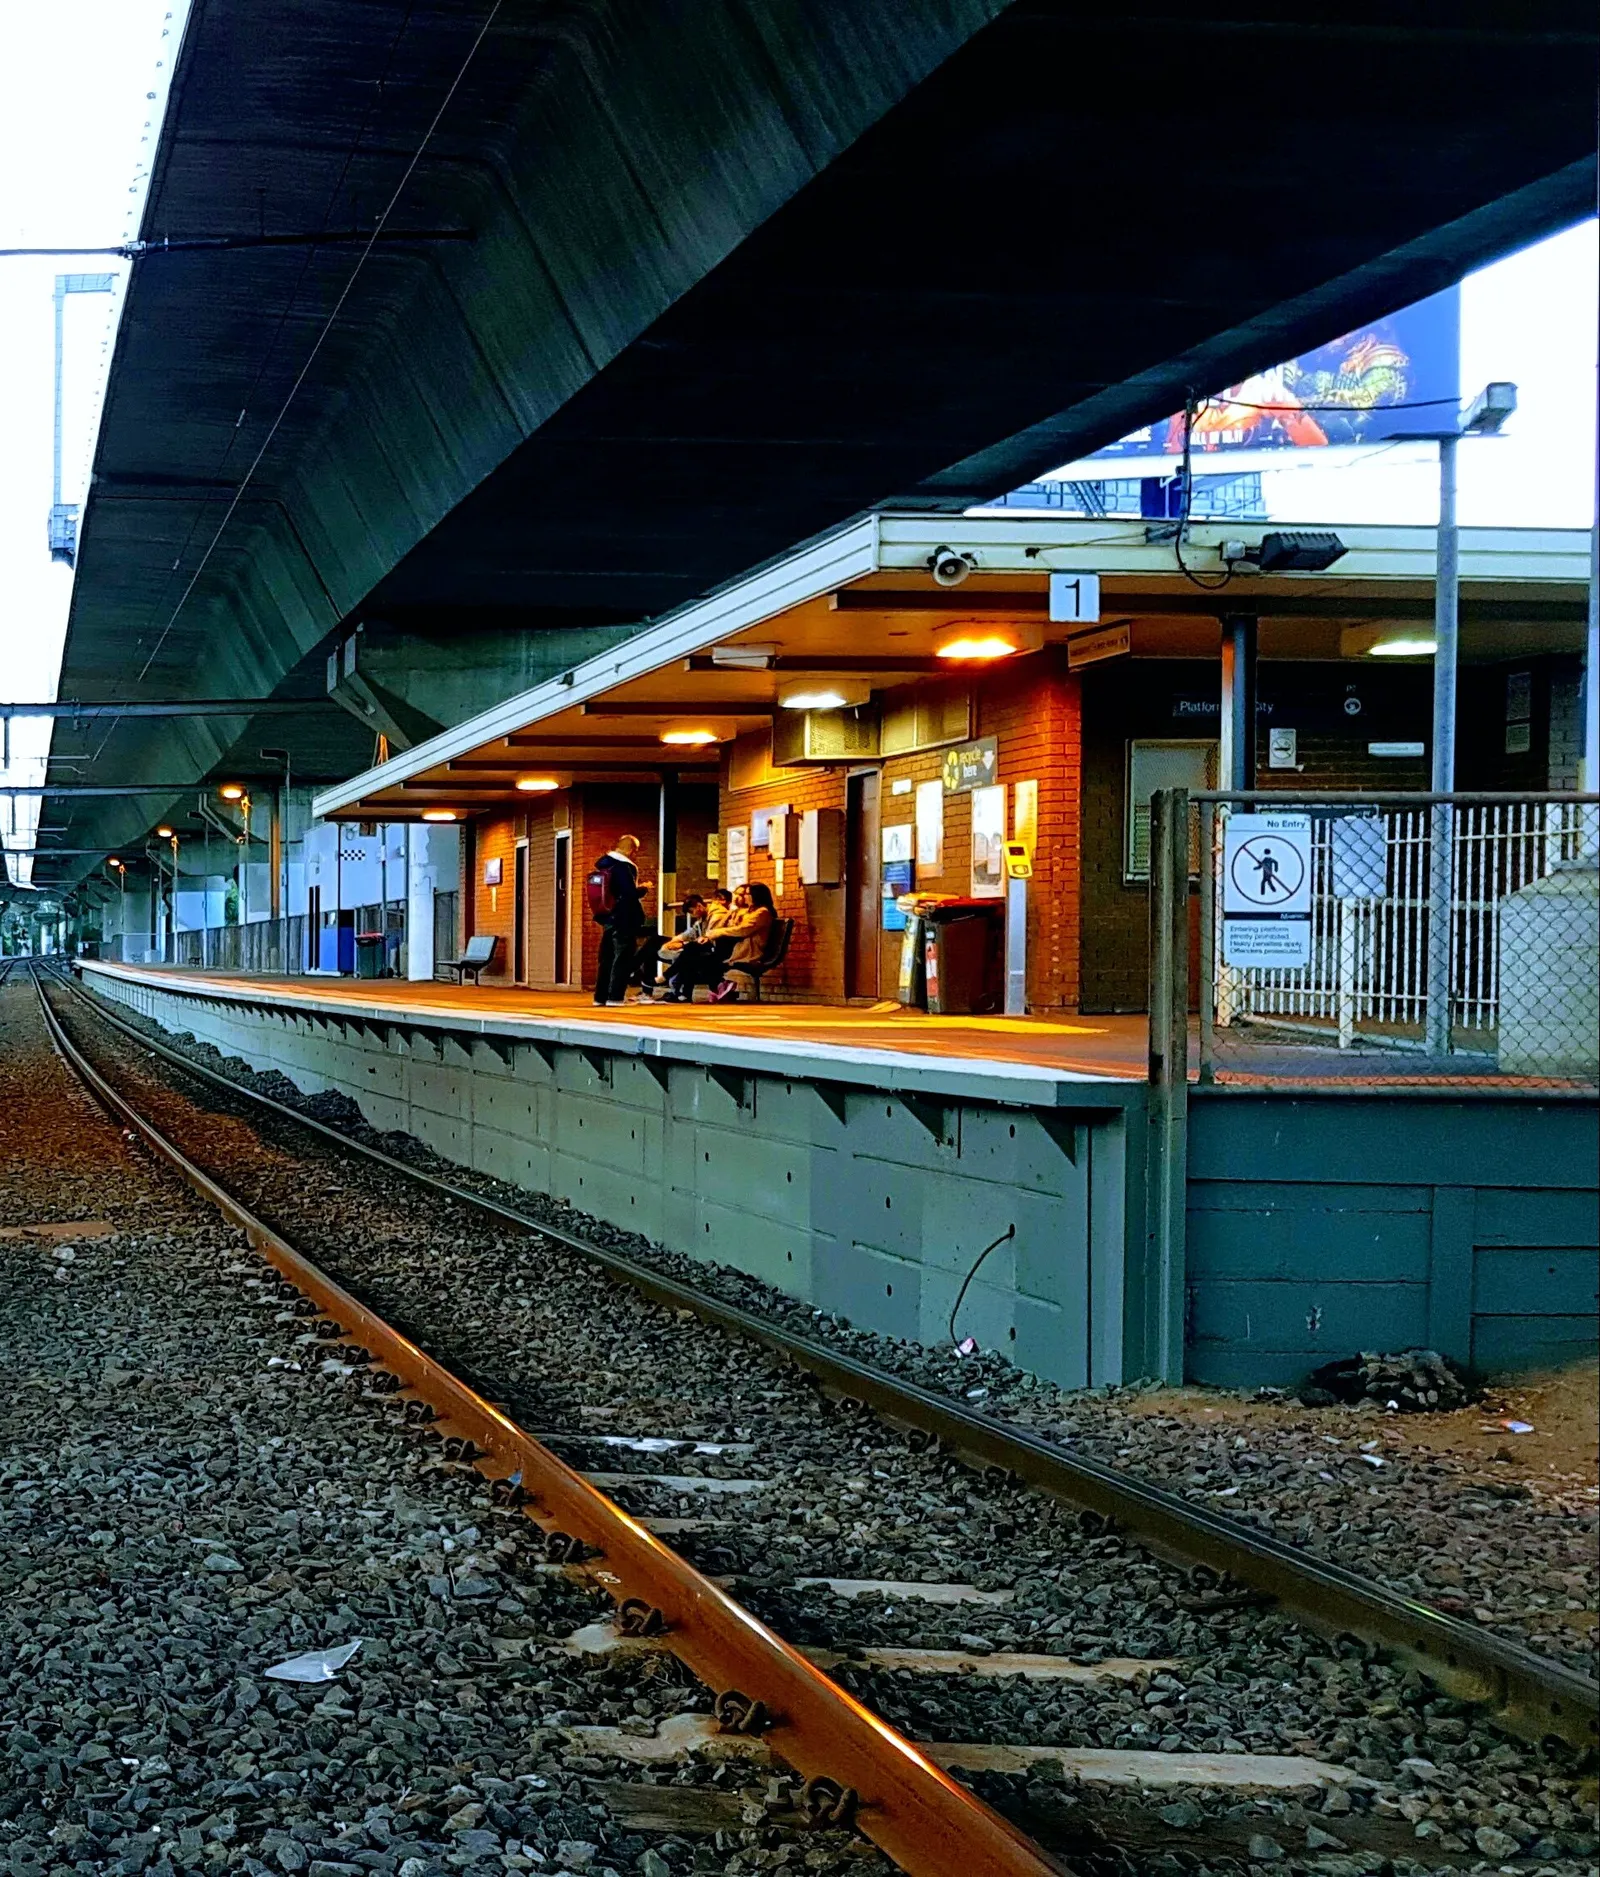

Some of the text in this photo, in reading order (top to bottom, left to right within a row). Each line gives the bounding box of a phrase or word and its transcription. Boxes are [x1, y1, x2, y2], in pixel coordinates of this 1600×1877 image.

[1064, 578, 1081, 618] 1
[1179, 701, 1221, 713] Platfor
[1267, 820, 1306, 829] No Entry
